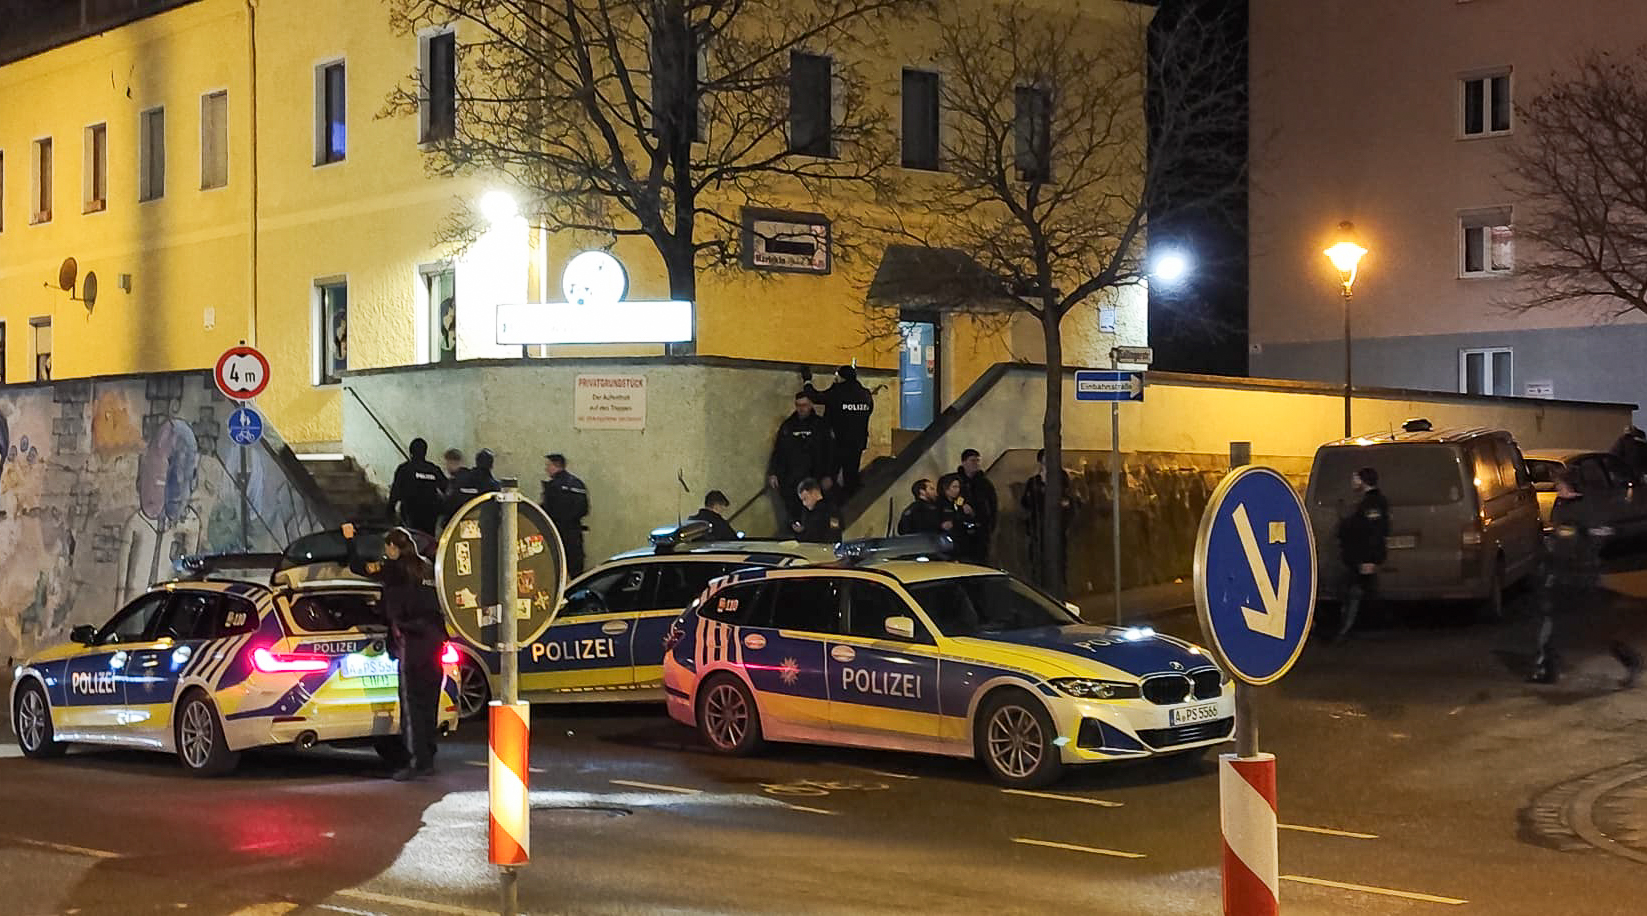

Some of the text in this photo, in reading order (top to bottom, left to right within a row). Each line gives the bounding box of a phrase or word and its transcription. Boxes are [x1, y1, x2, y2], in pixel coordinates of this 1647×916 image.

[230, 362, 256, 383] 4 m
[1080, 382, 1133, 391] Einbahnstraße
[313, 641, 357, 653] POLIZEI
[532, 638, 616, 663] POLIZEI
[72, 671, 116, 695] POLIZEI
[842, 667, 922, 699] POLIZEI
[1186, 709, 1197, 721] PS
